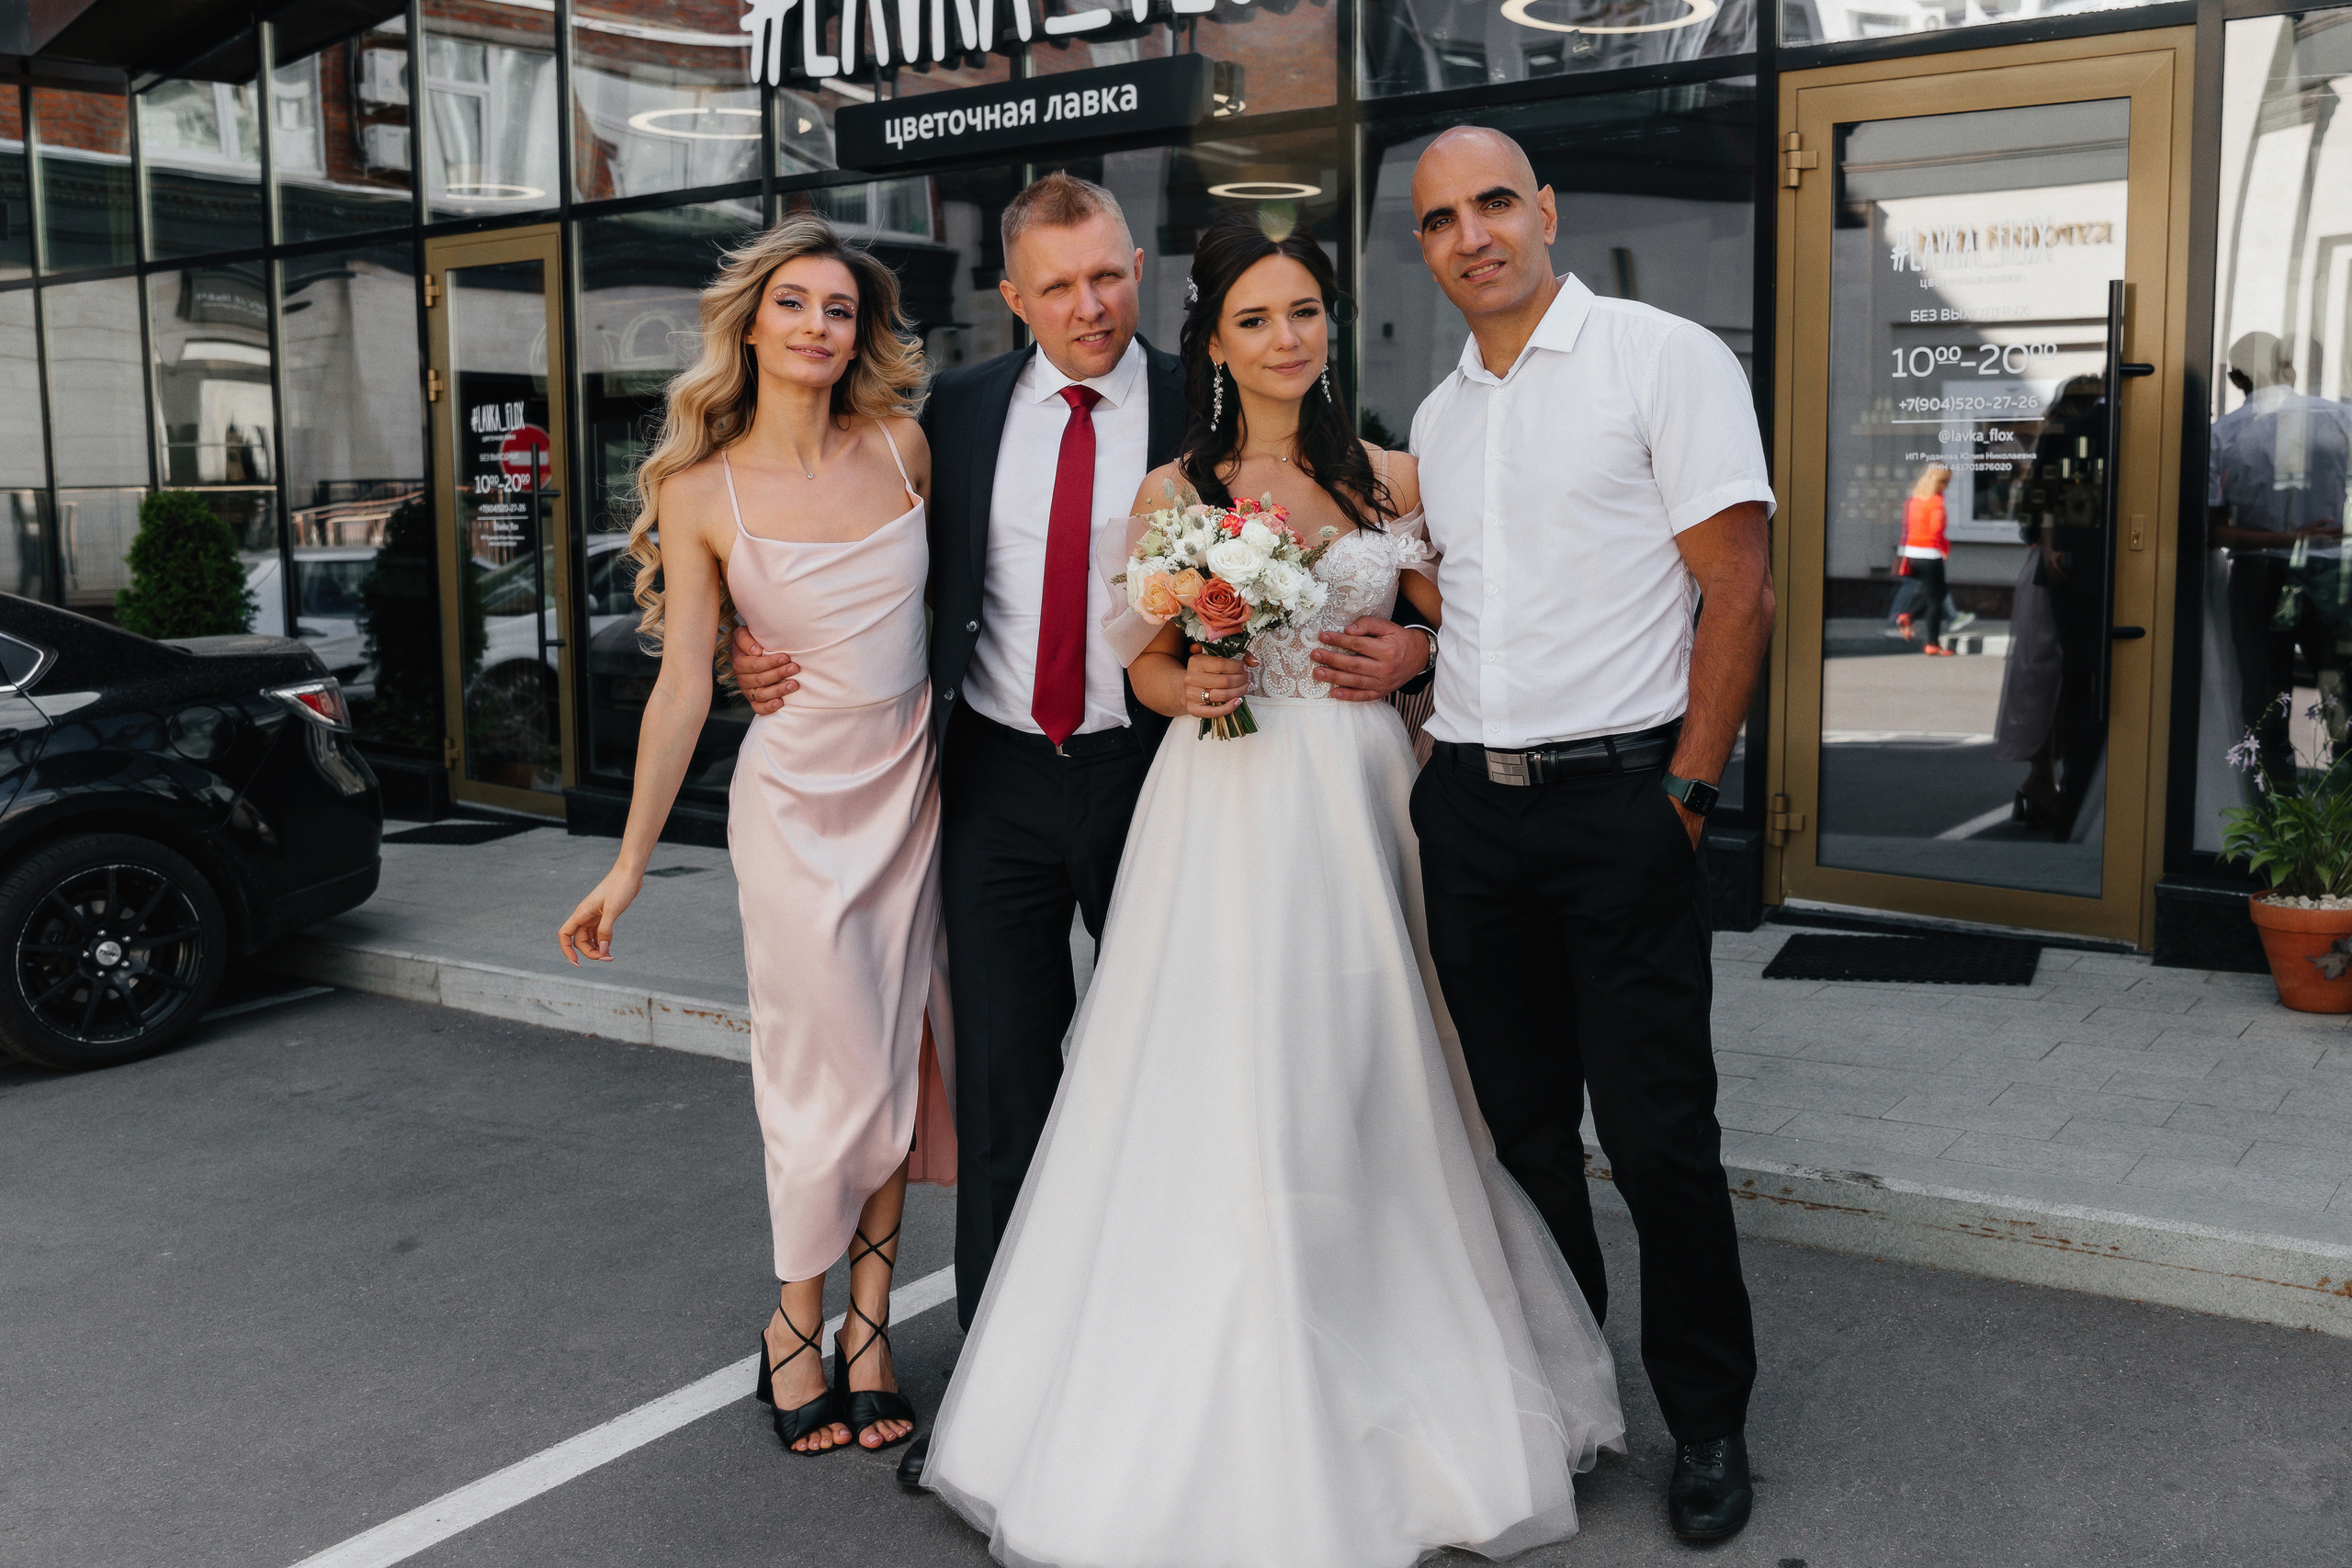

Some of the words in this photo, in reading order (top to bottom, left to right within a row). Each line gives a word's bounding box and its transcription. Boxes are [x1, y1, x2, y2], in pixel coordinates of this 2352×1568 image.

[885, 98, 1036, 150] цветочная
[1043, 84, 1138, 122] лавка
[1890, 215, 2051, 272] #LAVKA_FLOX
[1910, 310, 1938, 321] БЕЗ
[1898, 395, 2039, 412] +7(904)520-27-26
[1939, 428, 2014, 444] @lavka_flox
[1905, 452, 1919, 460] ИП
